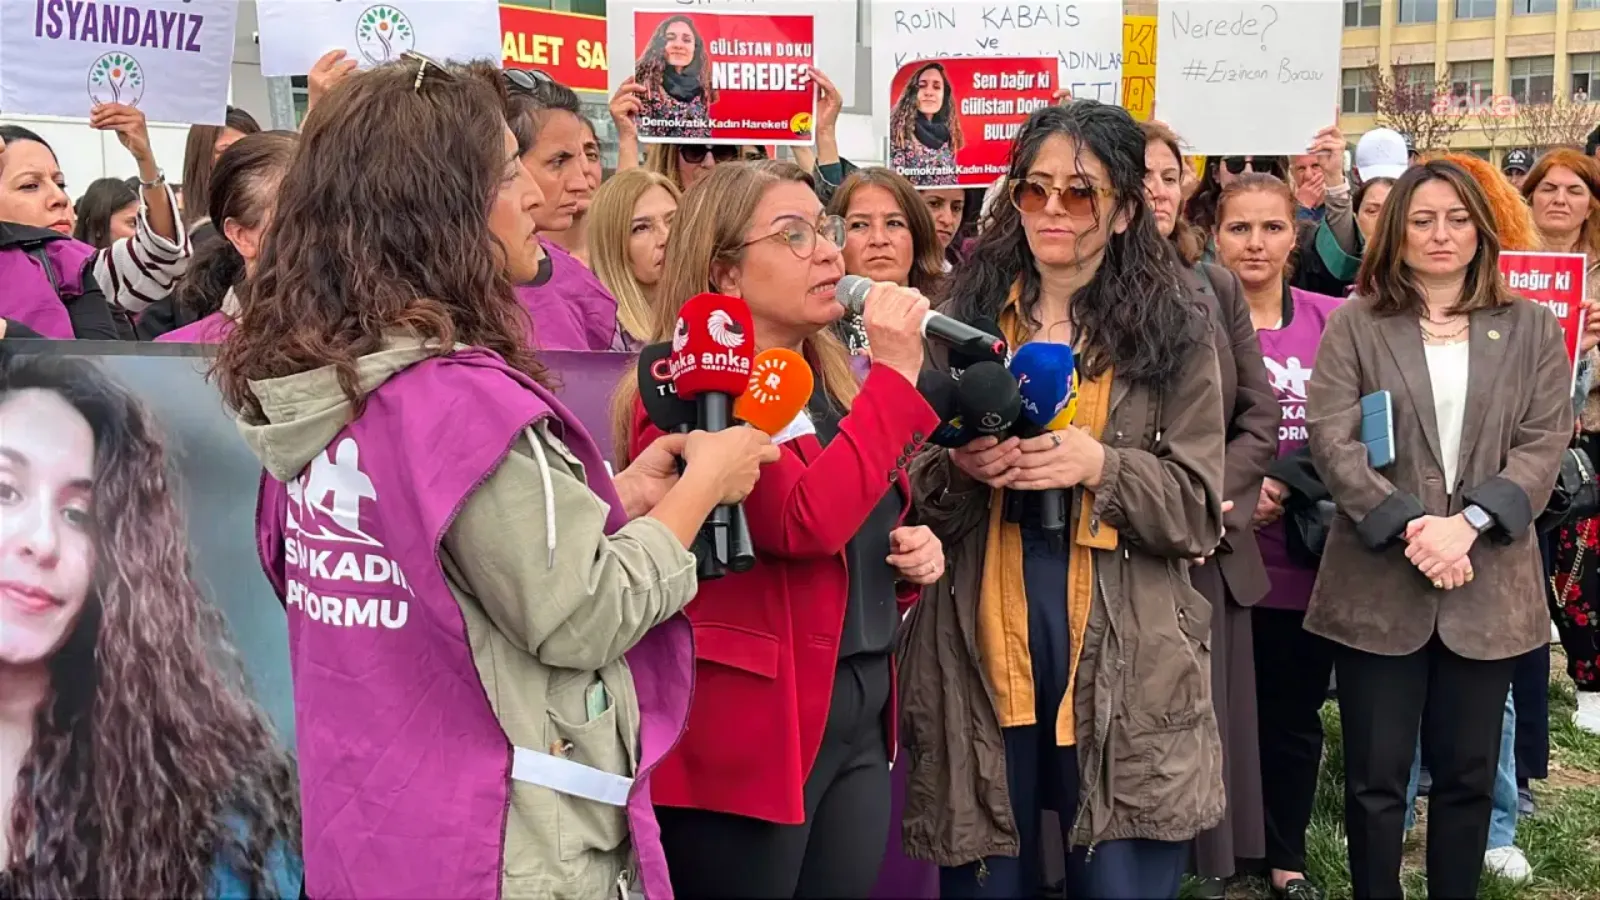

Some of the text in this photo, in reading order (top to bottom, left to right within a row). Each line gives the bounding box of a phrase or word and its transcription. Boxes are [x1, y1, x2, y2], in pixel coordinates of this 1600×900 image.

[1172, 4, 1278, 51] Nerede?
[502, 31, 608, 71] ALET SA
[710, 38, 812, 58] GÜLİSTAN DOKU
[976, 37, 999, 49] ve
[711, 62, 810, 91] NEREDE?
[973, 70, 1050, 91] Sen bağır ki
[961, 97, 1013, 115] Gülistan
[641, 116, 788, 130] Demokratik Kadın Hareketi
[896, 165, 954, 176] Demokratik
[955, 164, 983, 175] Kadın
[1509, 270, 1552, 290] bağır
[1554, 271, 1570, 290] ki
[701, 349, 750, 368] anka
[765, 372, 781, 390] R
